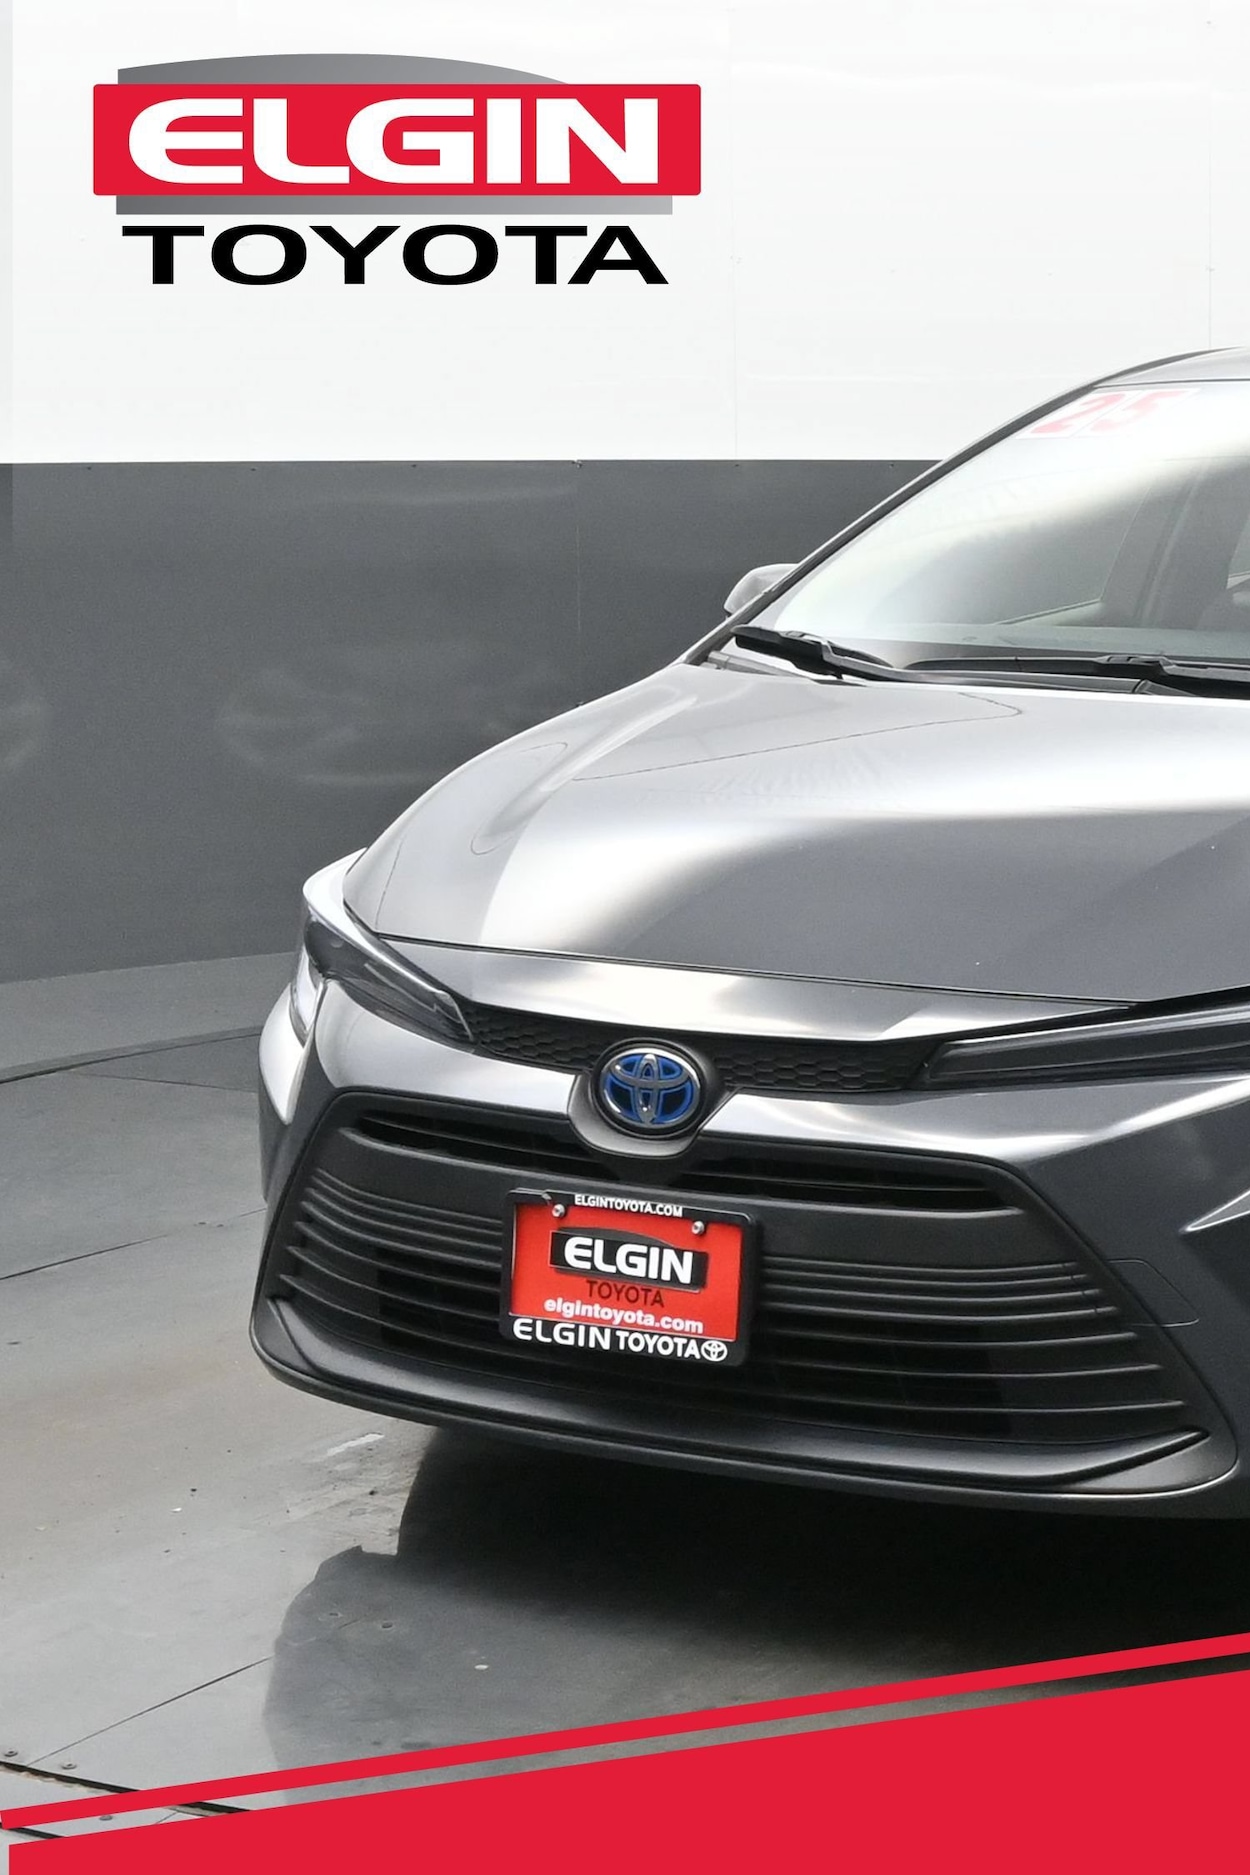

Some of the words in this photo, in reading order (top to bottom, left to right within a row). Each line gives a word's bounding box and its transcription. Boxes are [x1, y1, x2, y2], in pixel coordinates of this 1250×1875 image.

[1030, 390, 1187, 433] 25
[574, 1193, 683, 1218] ELGINTOYOTA.COM
[564, 1236, 693, 1284] ELGIN
[586, 1279, 665, 1308] TOYOTA
[544, 1297, 704, 1334] elgintoyota.com
[513, 1318, 611, 1351] ELGIN
[615, 1330, 701, 1360] TOYOTA
